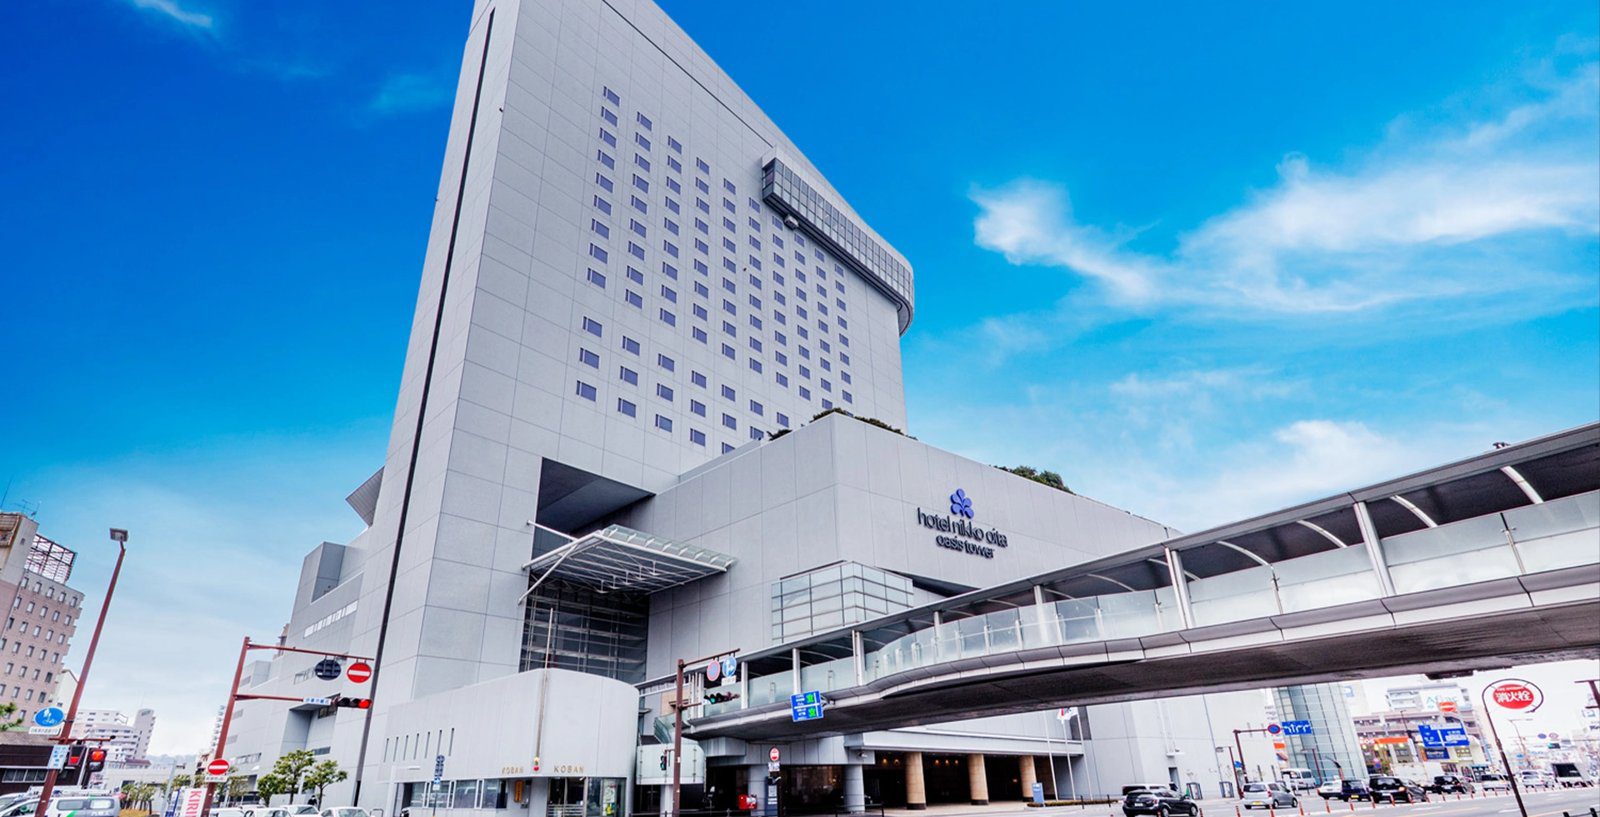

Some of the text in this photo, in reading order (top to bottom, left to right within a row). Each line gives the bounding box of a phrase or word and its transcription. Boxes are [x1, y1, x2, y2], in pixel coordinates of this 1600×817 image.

[917, 507, 1008, 548] hotel nikko oita
[936, 534, 994, 559] oasis tower
[1495, 690, 1532, 703] 消火栓
[553, 764, 584, 773] KOBAN
[185, 790, 202, 817] KIRI
